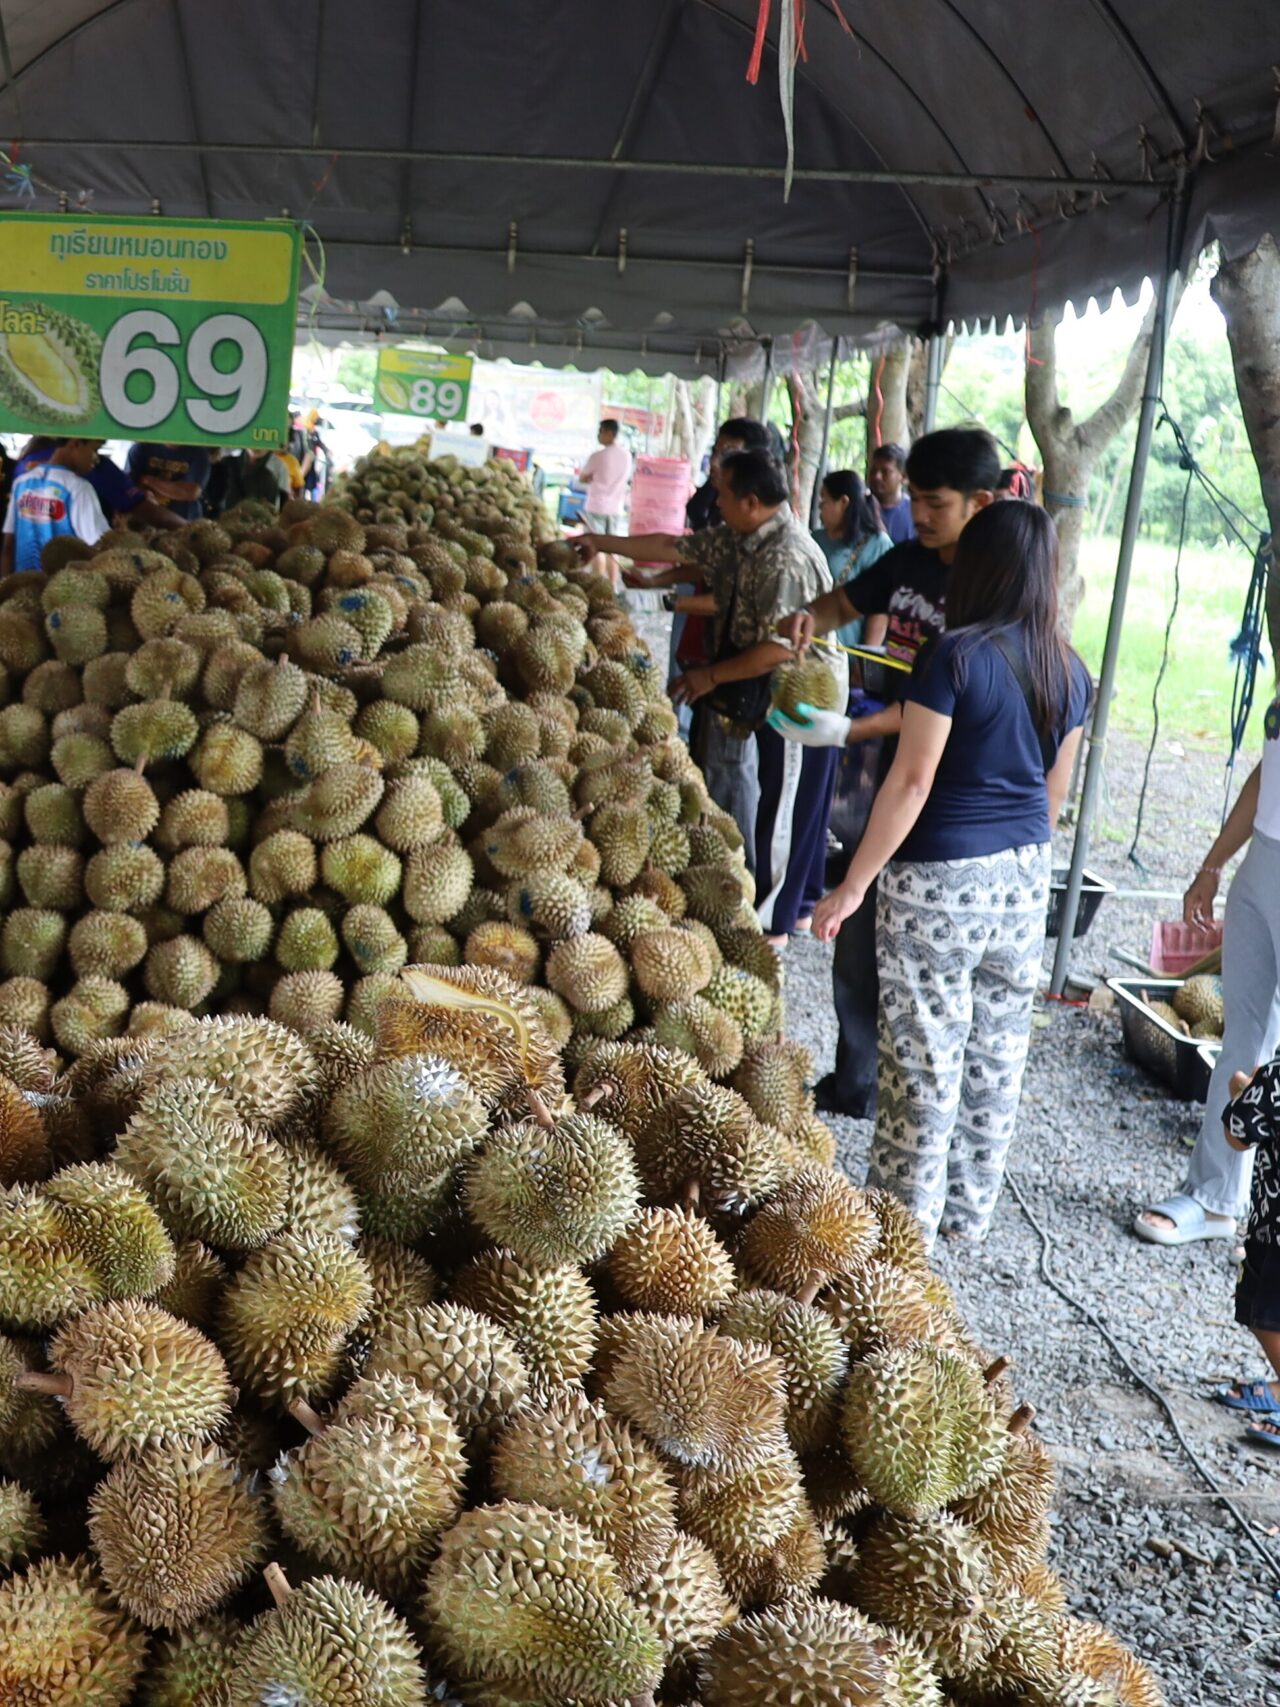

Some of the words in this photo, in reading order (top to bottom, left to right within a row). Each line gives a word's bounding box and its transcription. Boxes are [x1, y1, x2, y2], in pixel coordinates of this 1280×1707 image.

[50, 229, 228, 261] ทุเรียนหมอนทอง
[85, 267, 191, 294] ราคาโปรโมชั่น
[99, 309, 268, 434] 69
[409, 378, 463, 418] 89
